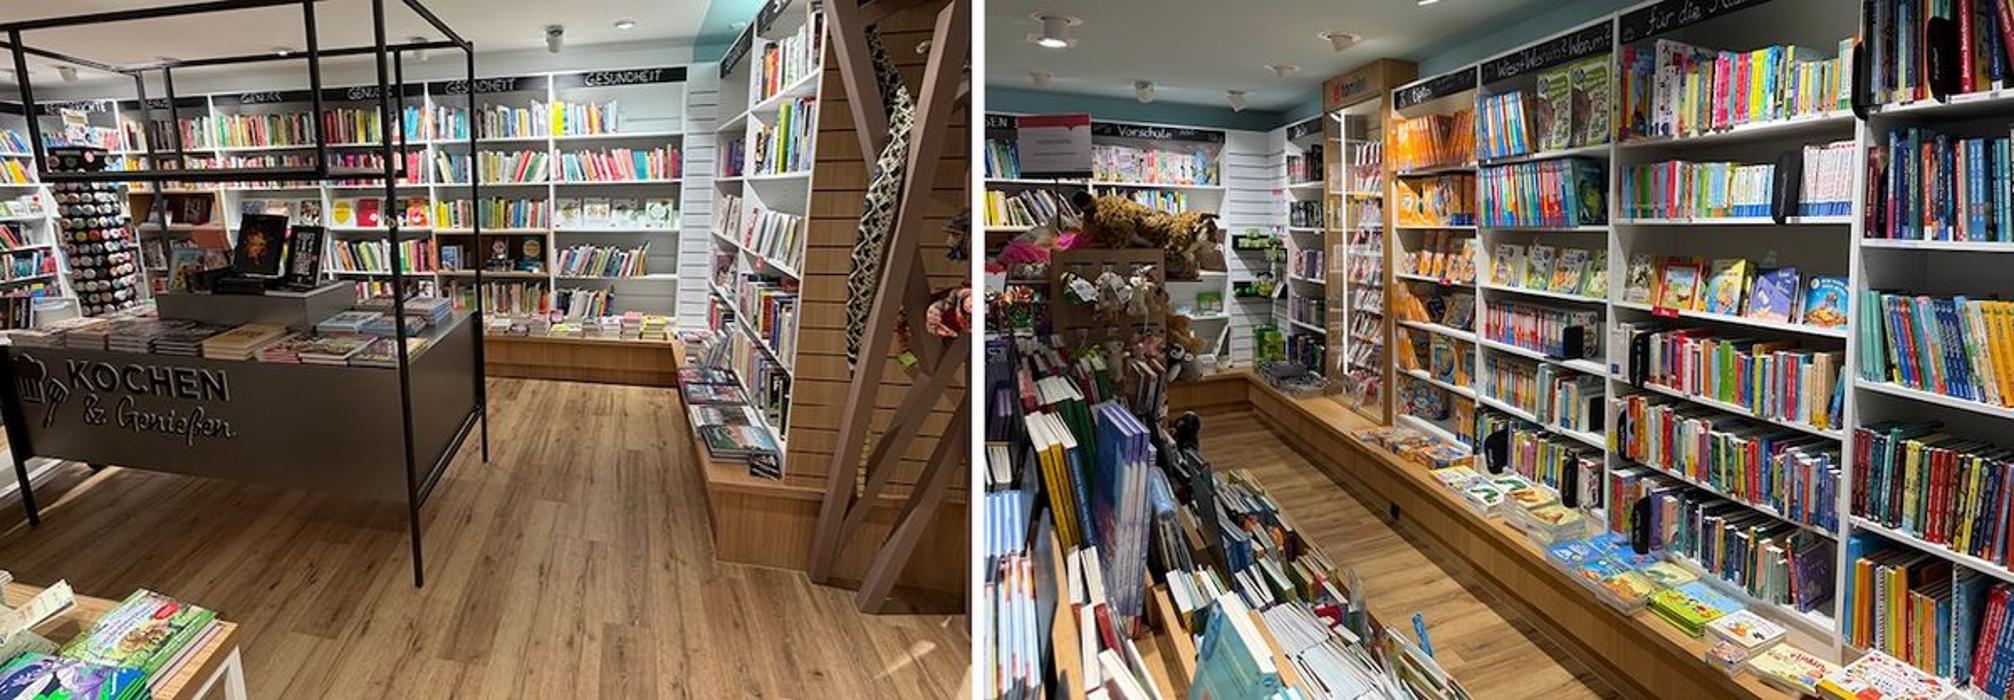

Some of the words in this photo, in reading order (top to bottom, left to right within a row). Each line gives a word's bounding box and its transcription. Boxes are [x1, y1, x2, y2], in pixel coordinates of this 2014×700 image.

[444, 78, 517, 95] GESNDHEIT
[583, 69, 663, 87] GESUNDHEIT
[66, 359, 231, 402] KOCHEN
[83, 393, 107, 425] &
